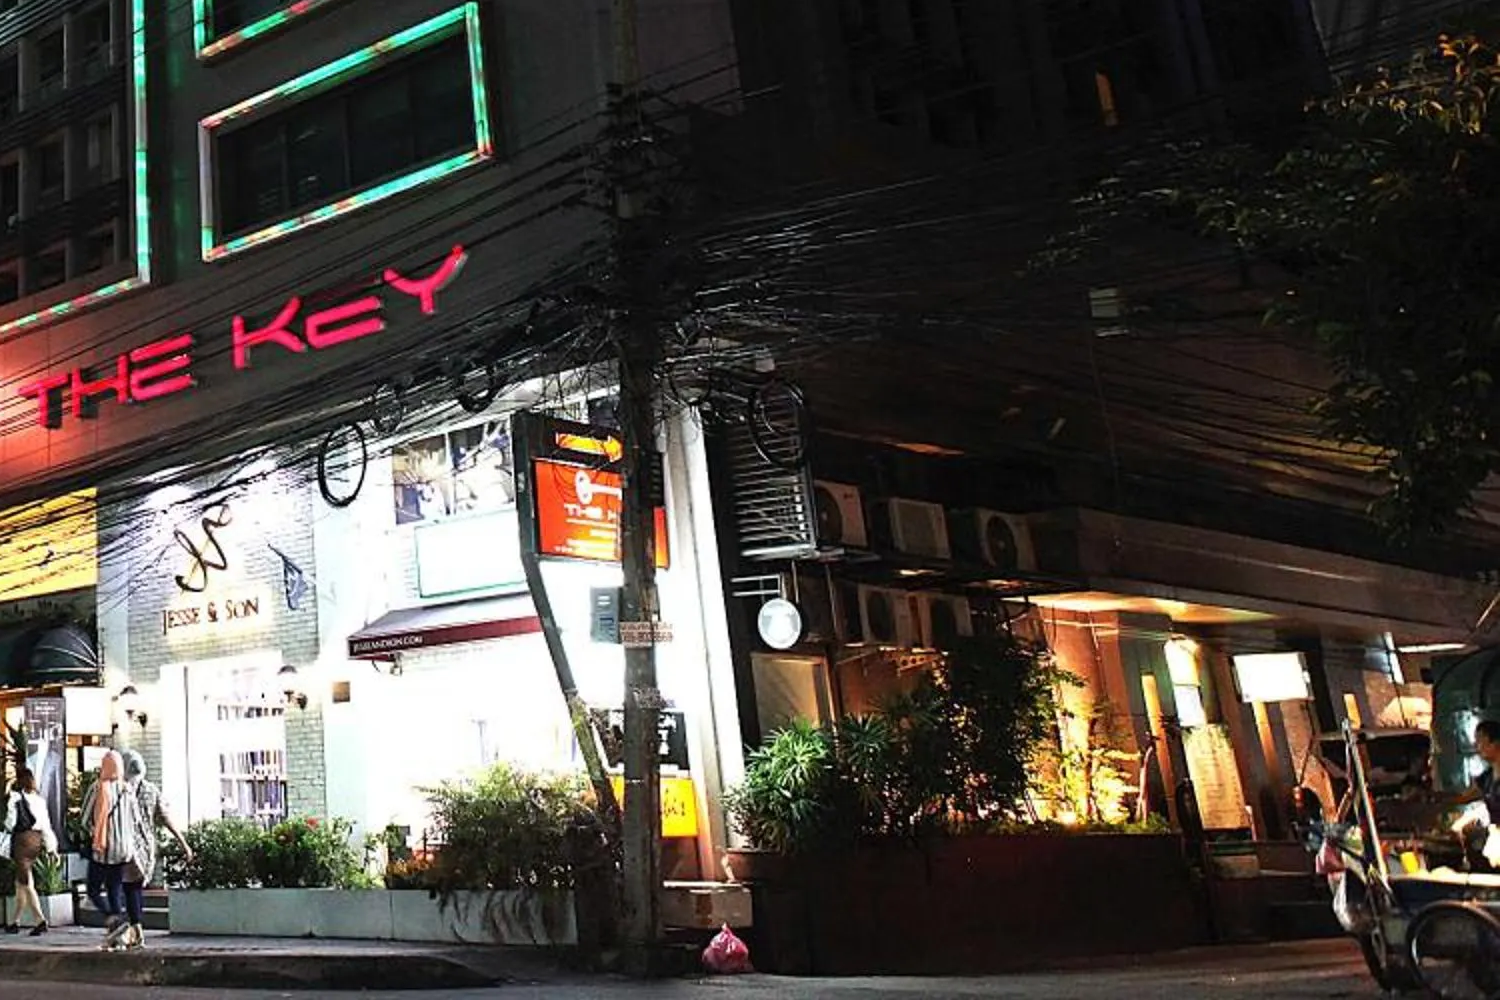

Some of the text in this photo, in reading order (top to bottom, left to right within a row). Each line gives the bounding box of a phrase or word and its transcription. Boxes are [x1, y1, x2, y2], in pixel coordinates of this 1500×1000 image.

[18, 244, 468, 430] THE KEY
[162, 607, 201, 636] JESSE
[225, 597, 259, 619] SON
